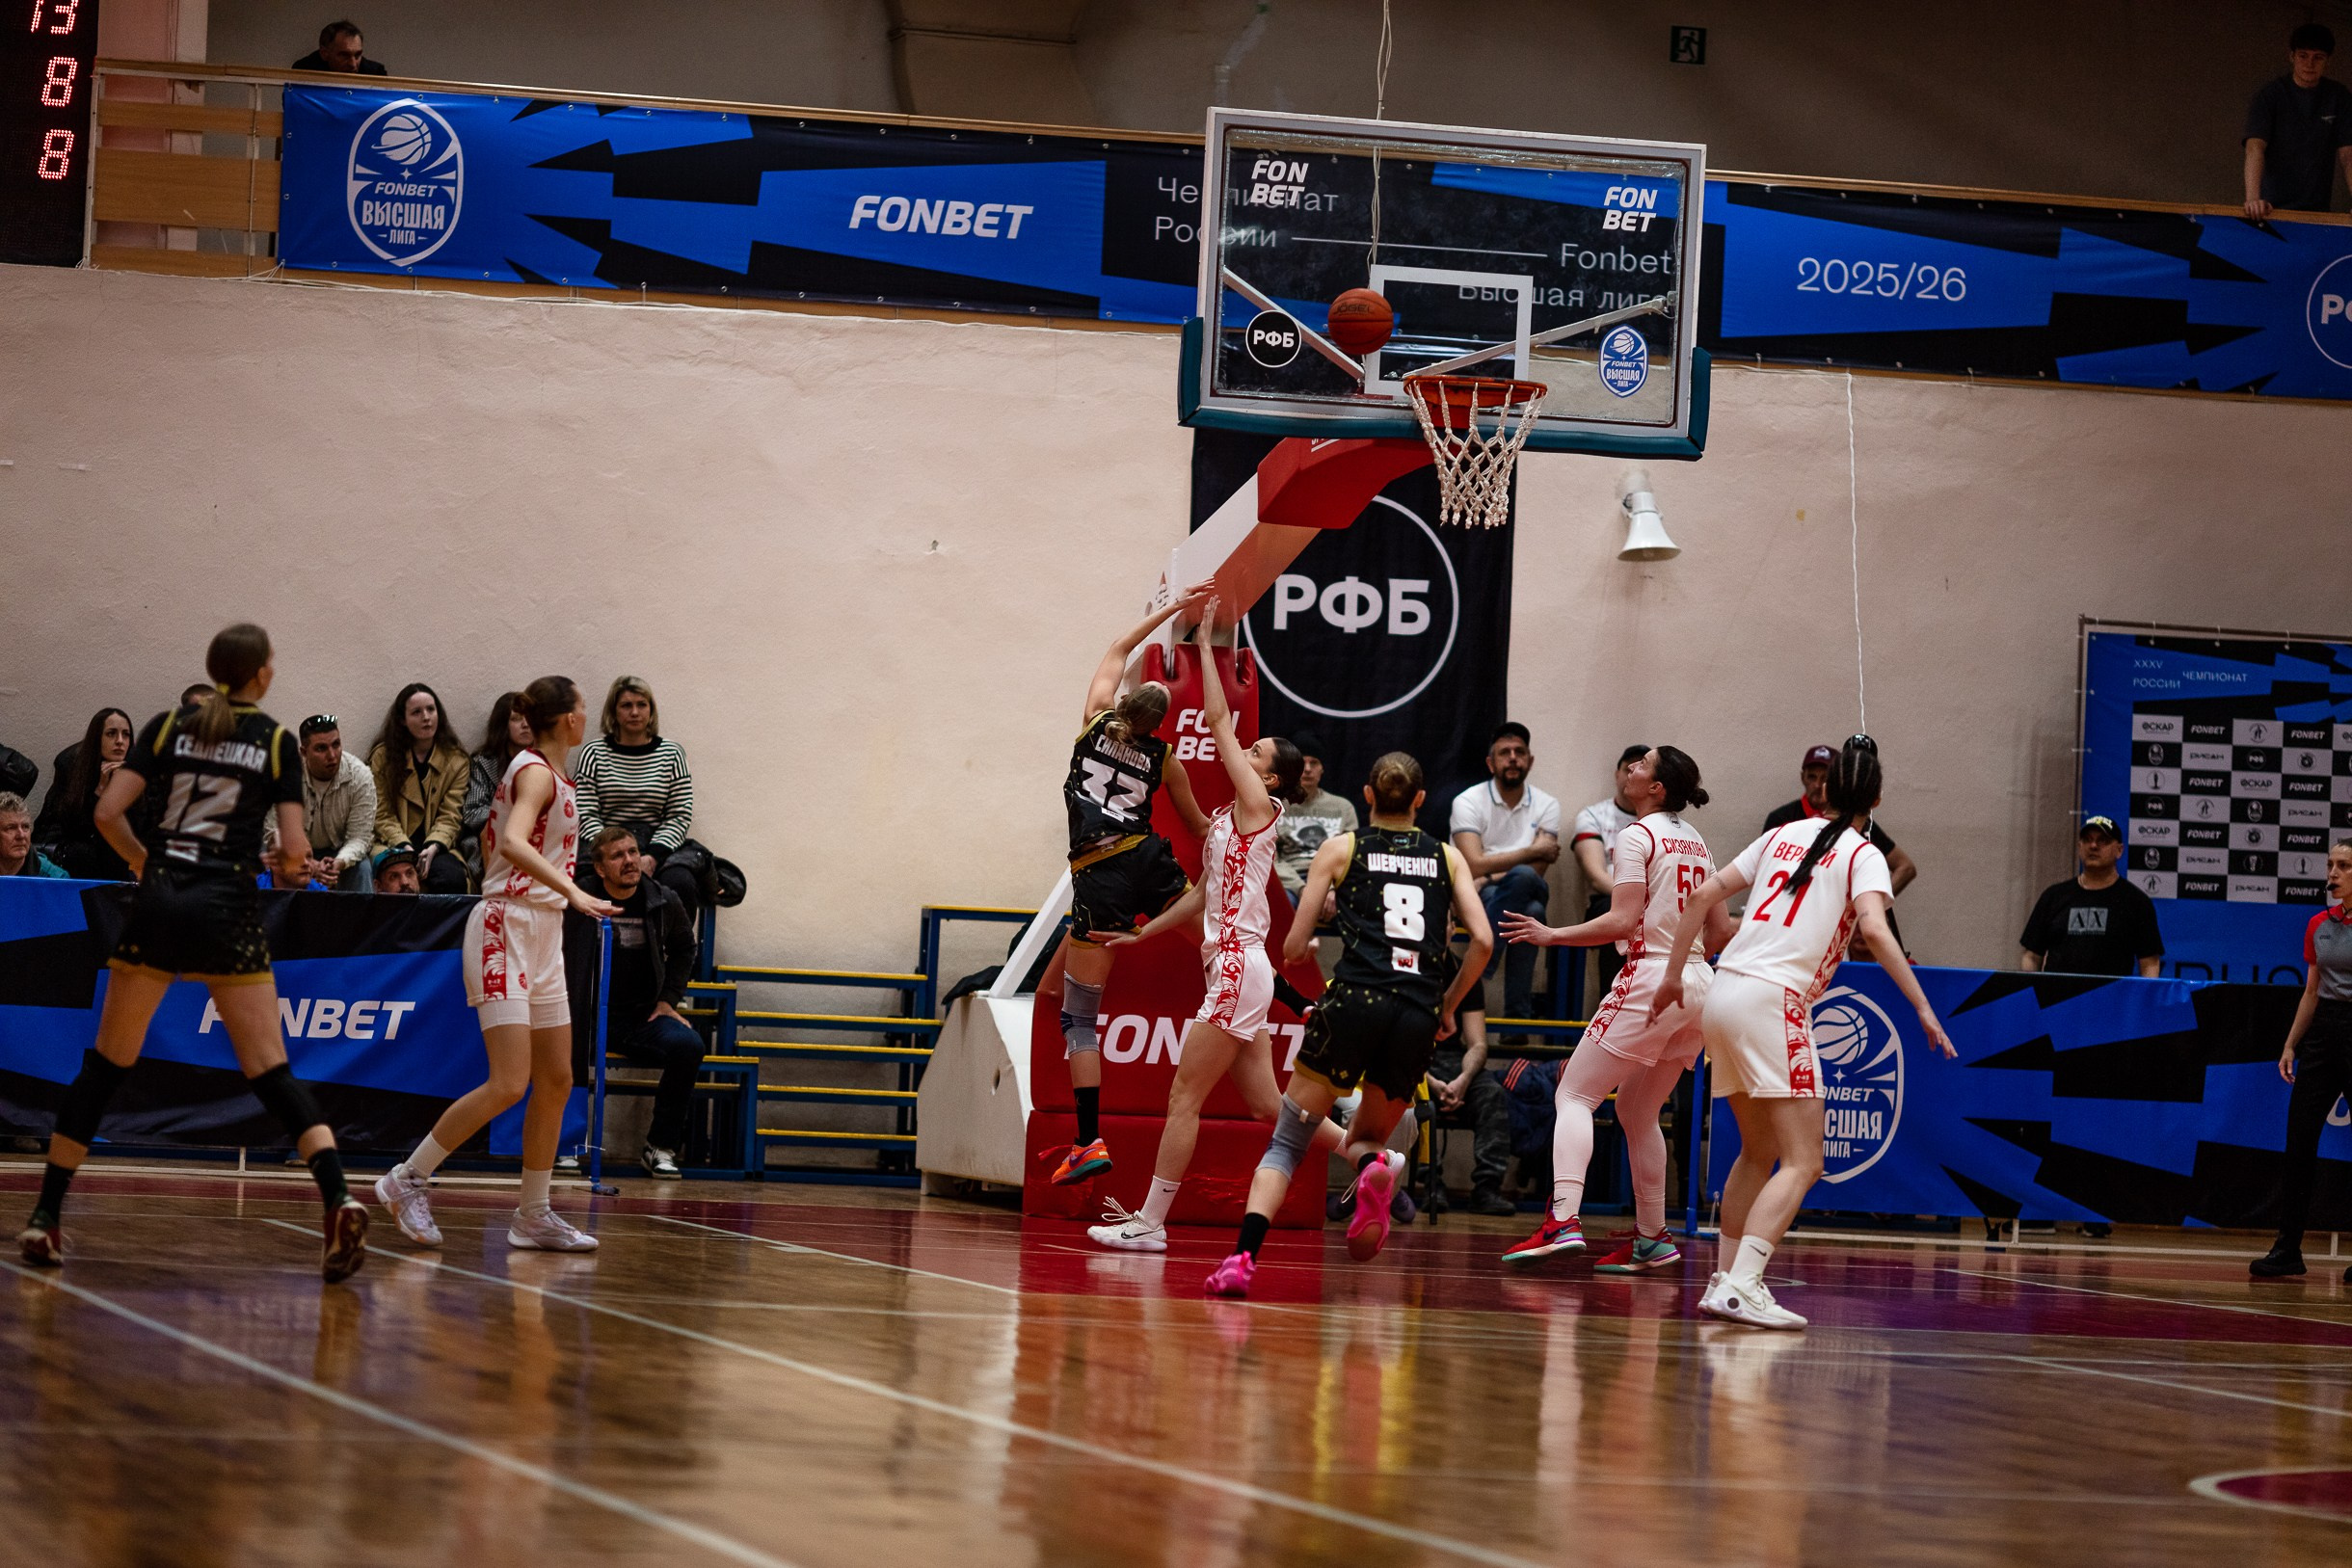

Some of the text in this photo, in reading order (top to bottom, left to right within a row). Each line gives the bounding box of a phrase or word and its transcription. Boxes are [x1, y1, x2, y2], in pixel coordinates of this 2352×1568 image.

[41, 57, 77, 106] 8
[39, 129, 74, 179] 8
[1251, 159, 1309, 183] FON
[375, 181, 438, 198] FONBET
[1250, 183, 1305, 206] BET
[1603, 186, 1659, 209] FON
[361, 199, 445, 230] ВЫСШАЯ
[848, 195, 1034, 240] FONBET
[1602, 209, 1657, 232] BET
[388, 229, 416, 246] ЛИГА
[1561, 243, 1672, 274] Fonbet
[1797, 256, 1967, 303] 2025/26
[1253, 328, 1295, 349] РФБ
[1606, 368, 1641, 381] ВЫСШАЯ
[1272, 574, 1431, 636] РФБ
[2132, 678, 2181, 689] РОССИИ
[2182, 671, 2248, 682] ЧЕМПИОНАТ
[2190, 725, 2226, 735] FONBET
[2290, 730, 2325, 740] FONBET
[2189, 779, 2224, 788] FONBET
[2289, 783, 2323, 793] FONBET
[158, 773, 241, 842] 12
[2187, 828, 2222, 838] FONBET
[2287, 835, 2321, 845] FONBET
[1367, 853, 1438, 878] ШЕВЧЕНКО
[2184, 881, 2220, 891] FONBET
[2285, 887, 2320, 897] FONBET
[1382, 882, 1426, 942] 8
[199, 999, 415, 1040] FNBET
